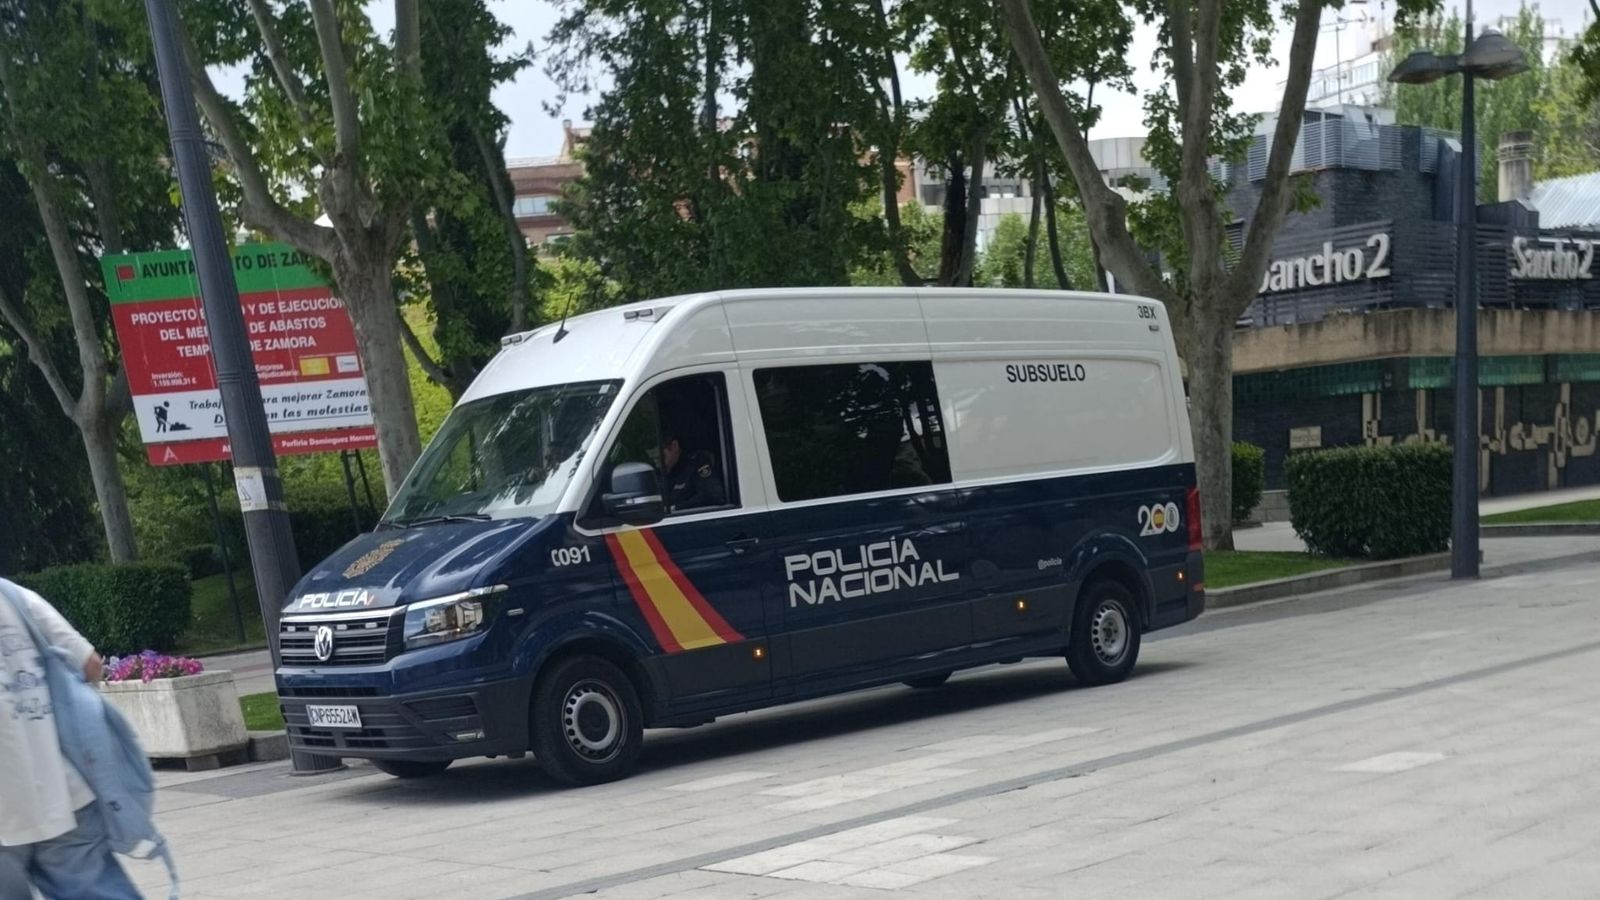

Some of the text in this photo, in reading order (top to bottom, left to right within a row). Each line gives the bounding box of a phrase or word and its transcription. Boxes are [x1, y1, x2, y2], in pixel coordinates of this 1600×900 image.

[257, 253, 276, 268] DE
[1366, 233, 1390, 278] 2
[1511, 236, 1593, 279] Sancho 2
[131, 308, 197, 325] PROYECTO
[248, 304, 256, 316] Y
[259, 302, 276, 315] DE
[1137, 305, 1157, 320] 3BX
[160, 329, 185, 341] DEL
[249, 321, 266, 334] DE
[269, 316, 326, 332] ABASTOS
[176, 344, 210, 358] TEMP
[265, 335, 317, 351] ZAMORA
[1006, 363, 1086, 383] SUBSUELO
[189, 398, 222, 410] Trabaj
[281, 391, 322, 404] mejorar
[326, 389, 366, 399] Zamora
[283, 408, 301, 419] las
[307, 402, 369, 416] molestias
[1138, 502, 1179, 537] 200
[784, 536, 920, 580] POLICÍA
[789, 559, 960, 607] NACIONAL
[300, 587, 369, 608] POLICÍA
